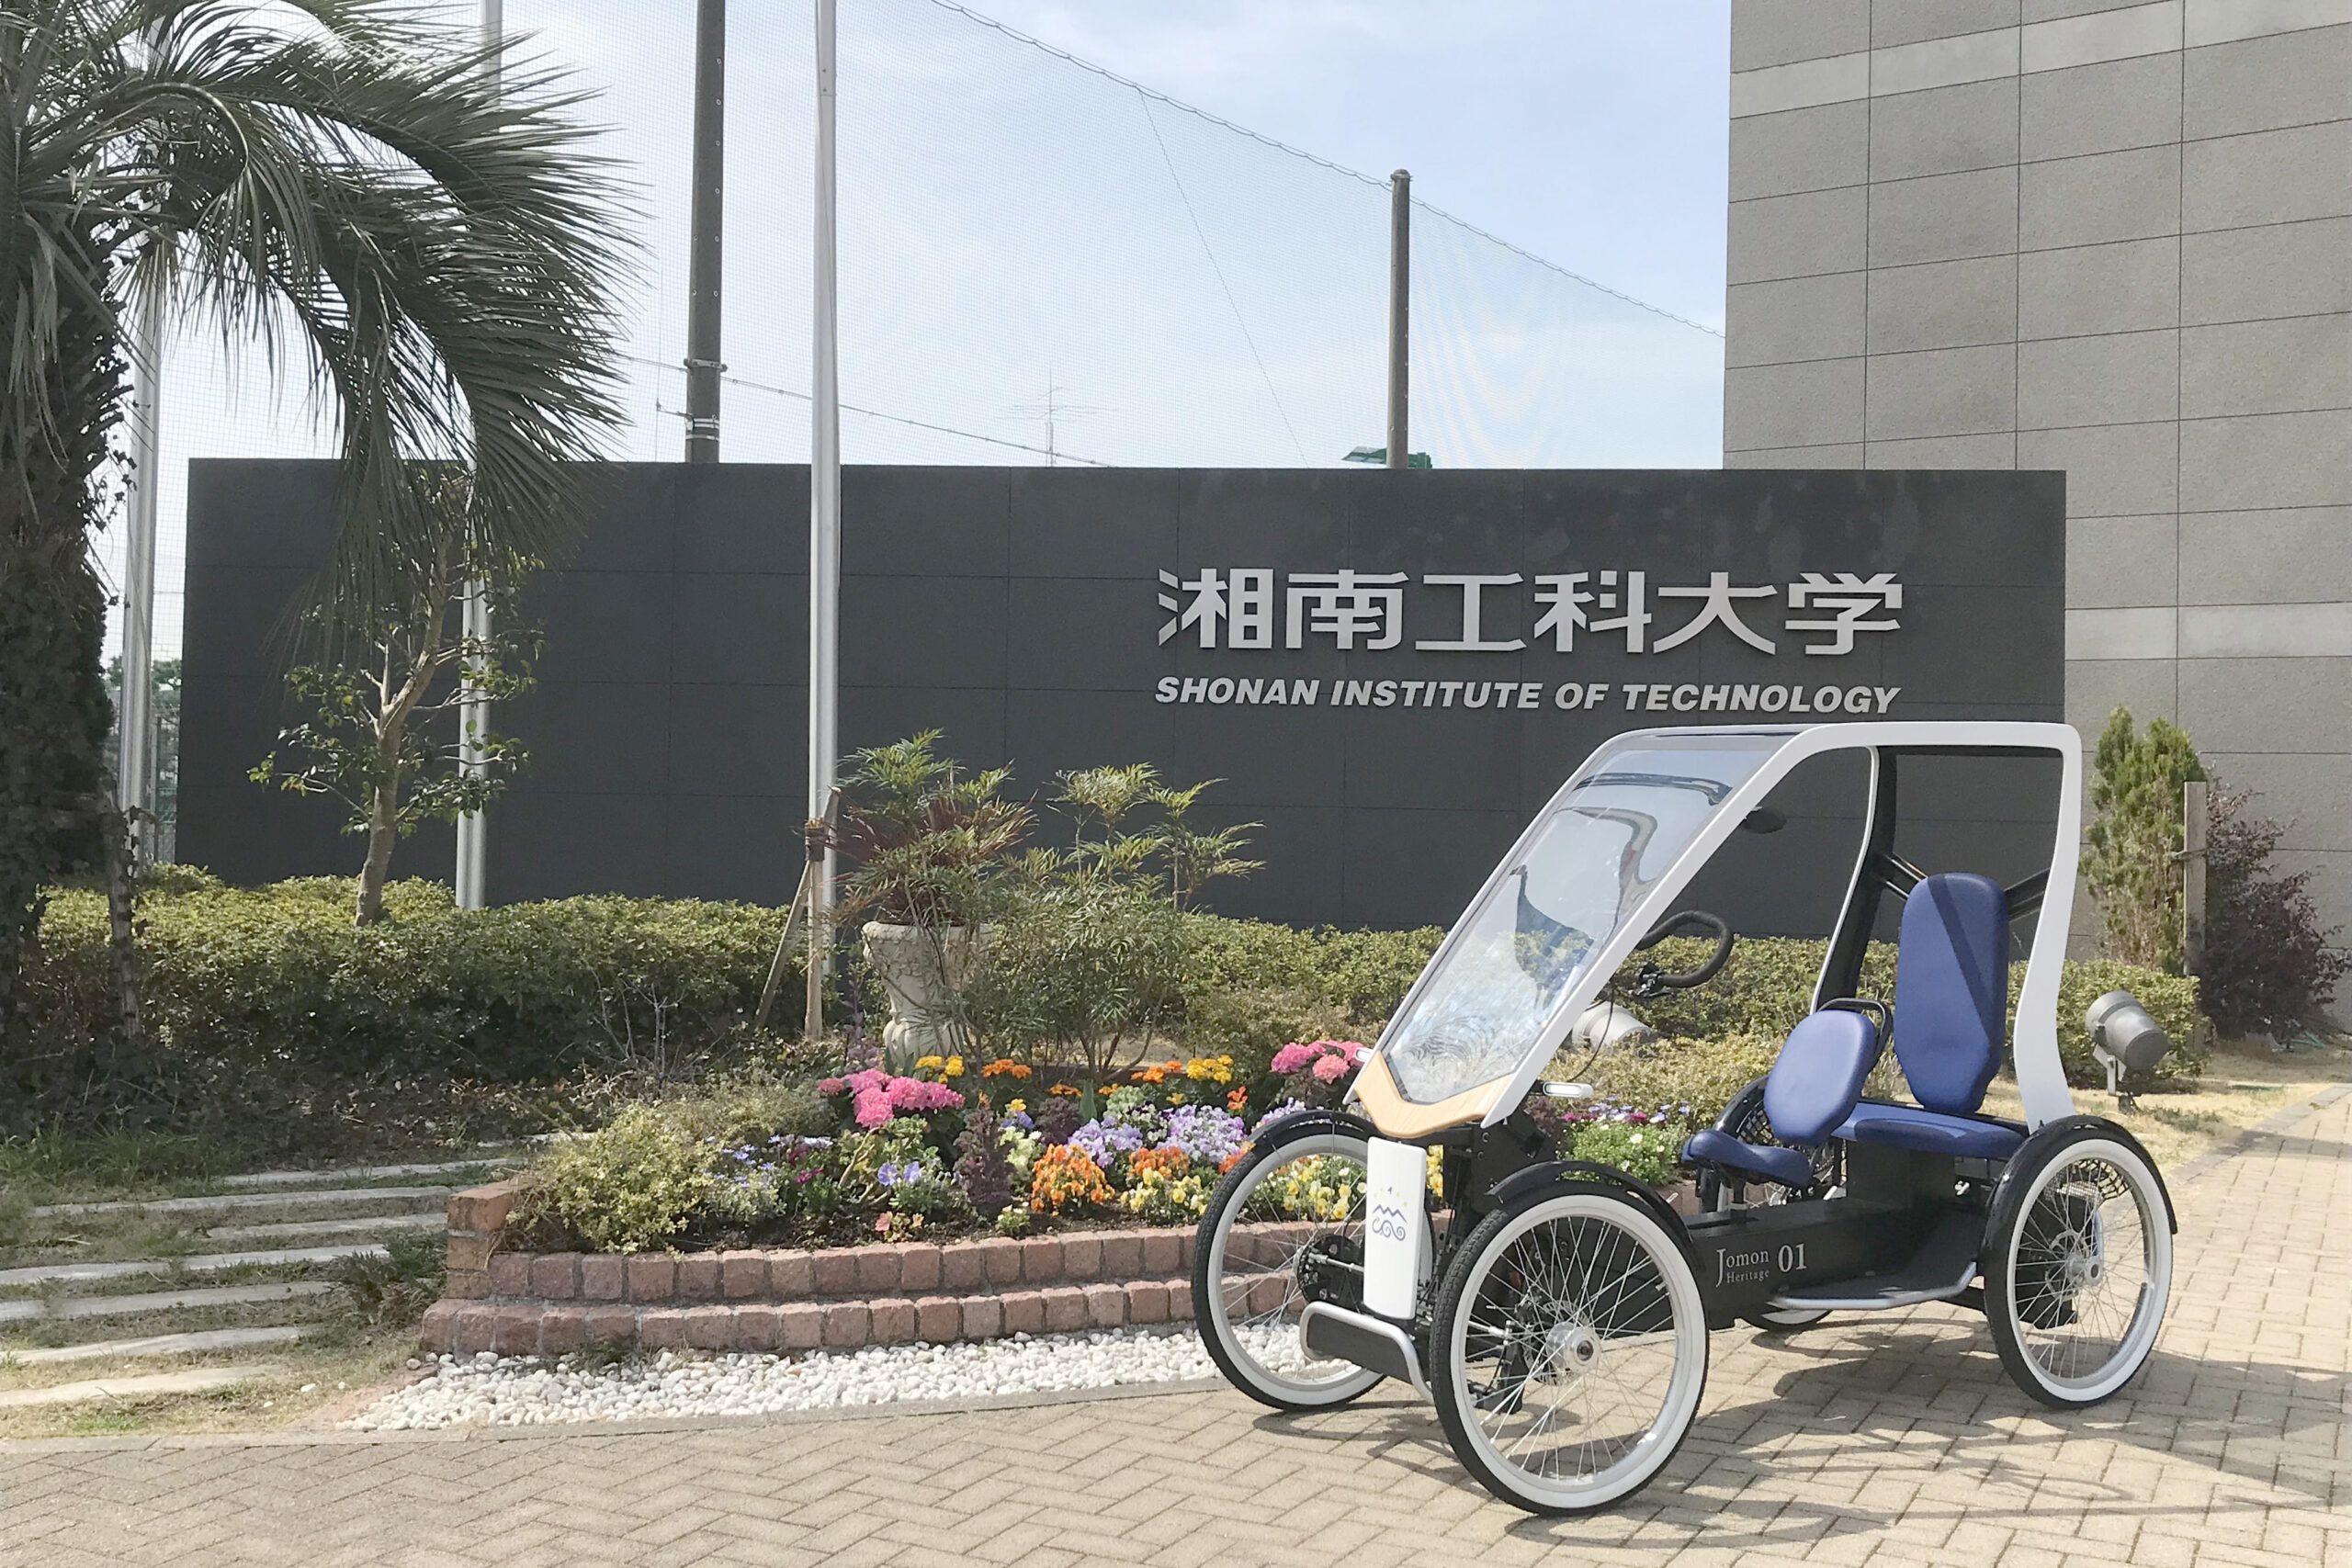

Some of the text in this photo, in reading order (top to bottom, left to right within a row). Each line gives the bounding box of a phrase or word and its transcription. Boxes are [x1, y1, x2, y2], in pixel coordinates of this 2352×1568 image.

[1158, 568, 1903, 655] 湘南工科大学
[1155, 676, 1901, 714] SHONAN INSTITUTE OF TECHNOLOGY
[1715, 1243, 1807, 1287] Jomon 01
[1726, 1269, 1770, 1283] Heritage
